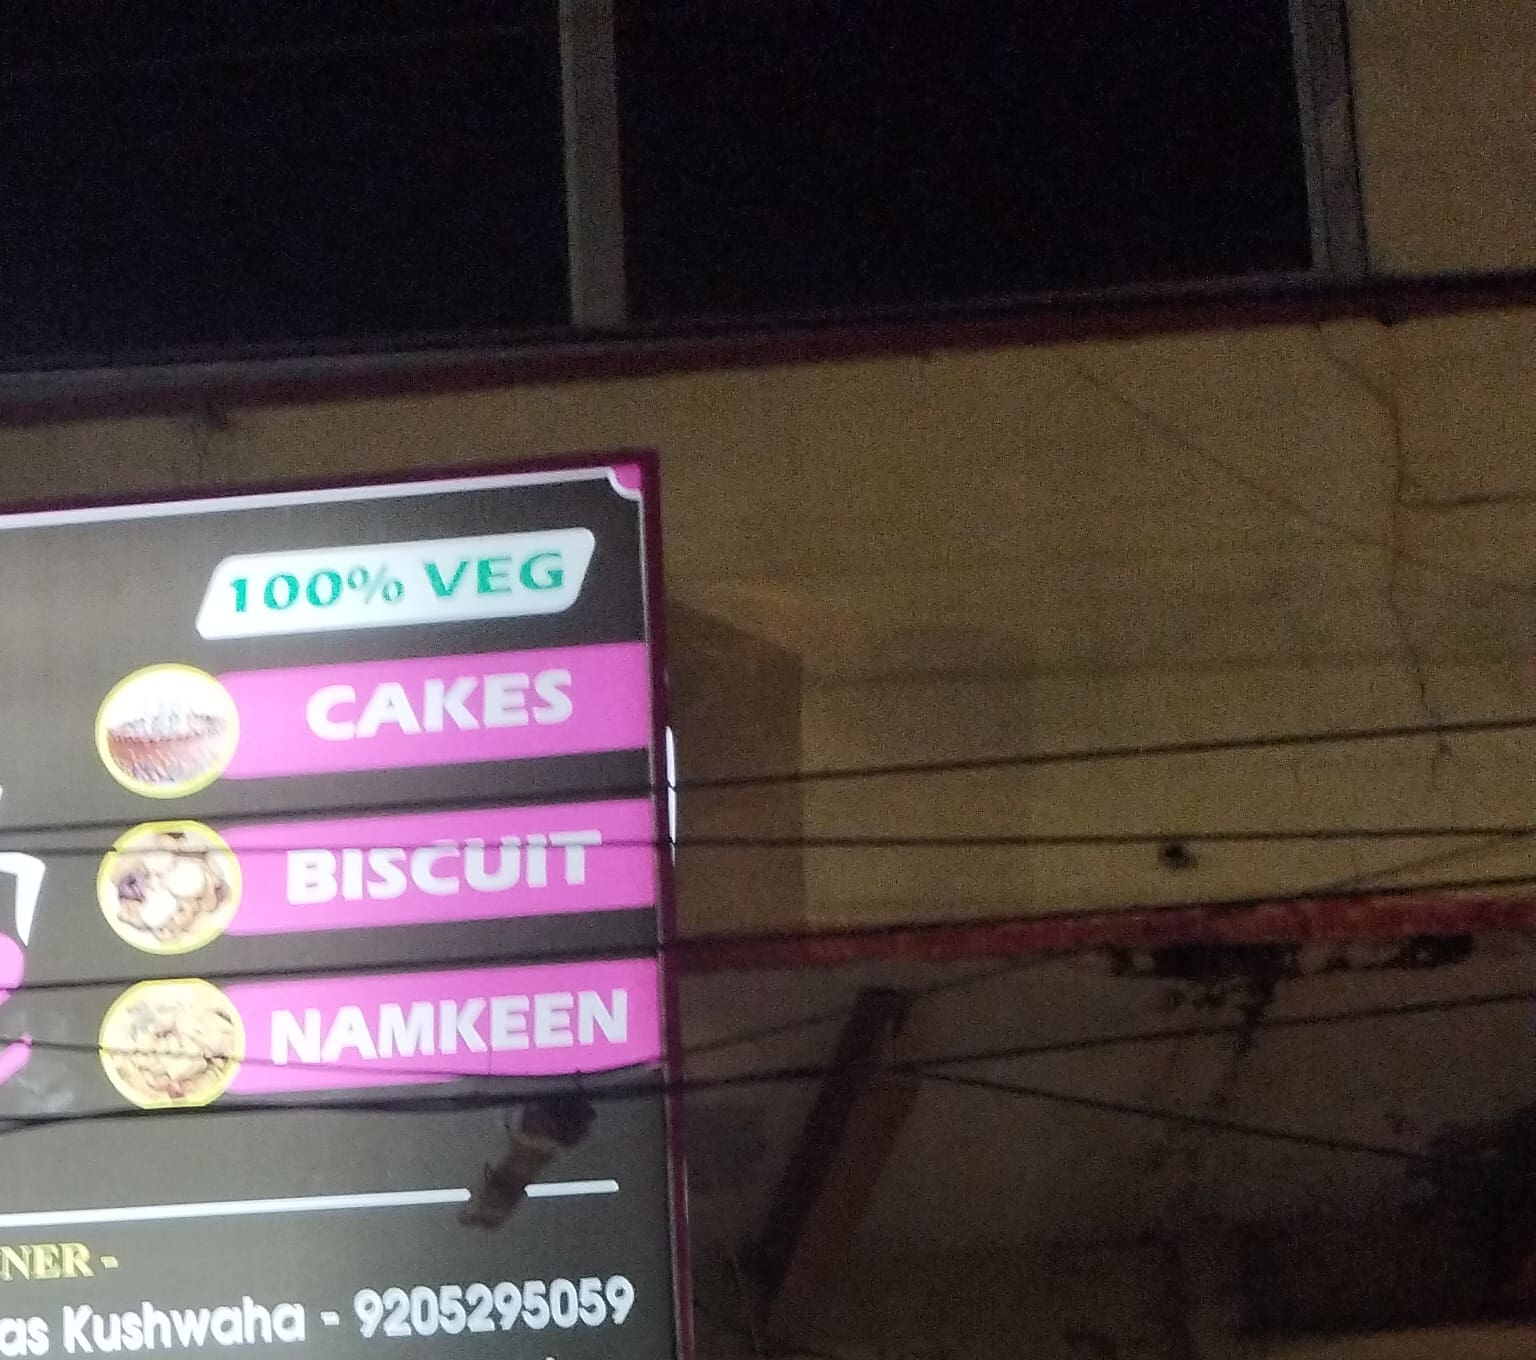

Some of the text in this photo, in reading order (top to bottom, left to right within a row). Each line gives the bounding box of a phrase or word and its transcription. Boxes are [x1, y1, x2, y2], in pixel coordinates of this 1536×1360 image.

[228, 550, 566, 614] 100% VEG
[305, 669, 573, 742] CAKES
[286, 829, 602, 906] BISCUIT
[270, 988, 629, 1066] NAMKEEN
[63, 1295, 307, 1356] Kushwaha
[353, 1274, 637, 1340] 9205295059
